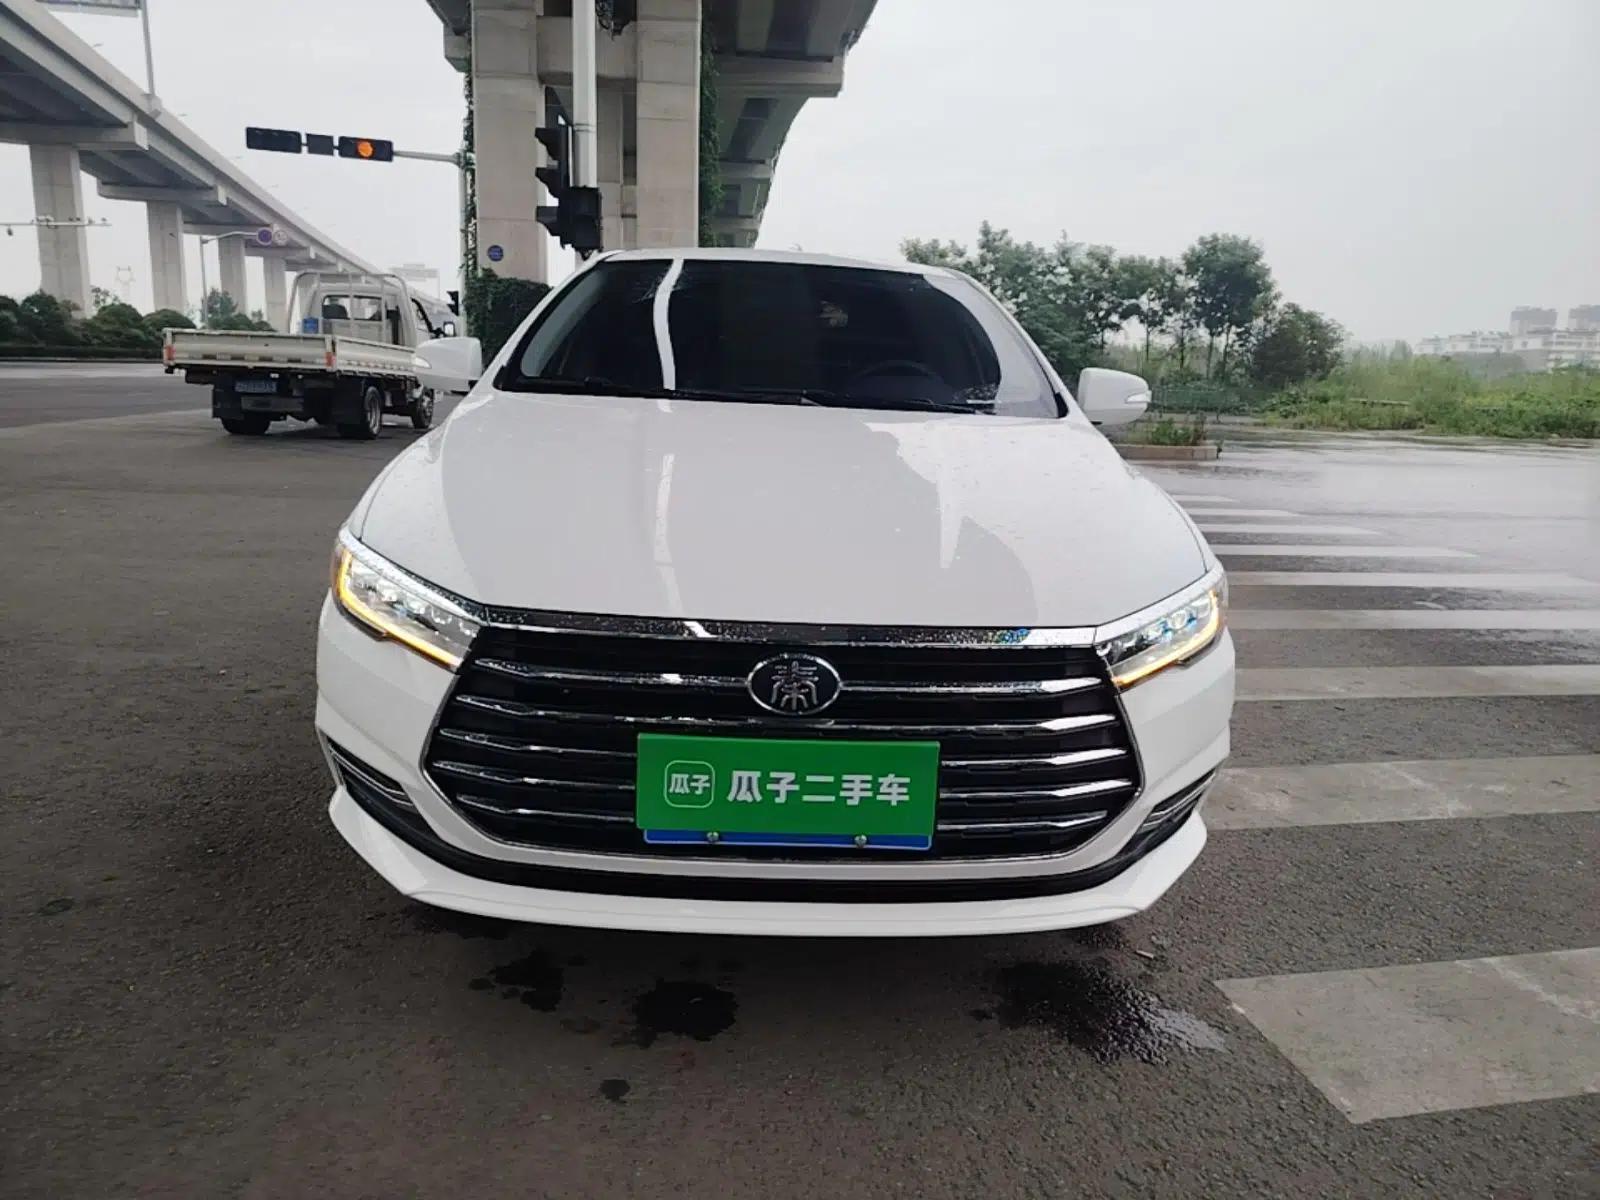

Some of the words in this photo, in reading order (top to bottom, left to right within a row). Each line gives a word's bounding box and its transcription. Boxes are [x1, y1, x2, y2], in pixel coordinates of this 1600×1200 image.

[669, 773, 711, 795] 瓜子
[727, 770, 911, 806] 瓜子二手车
